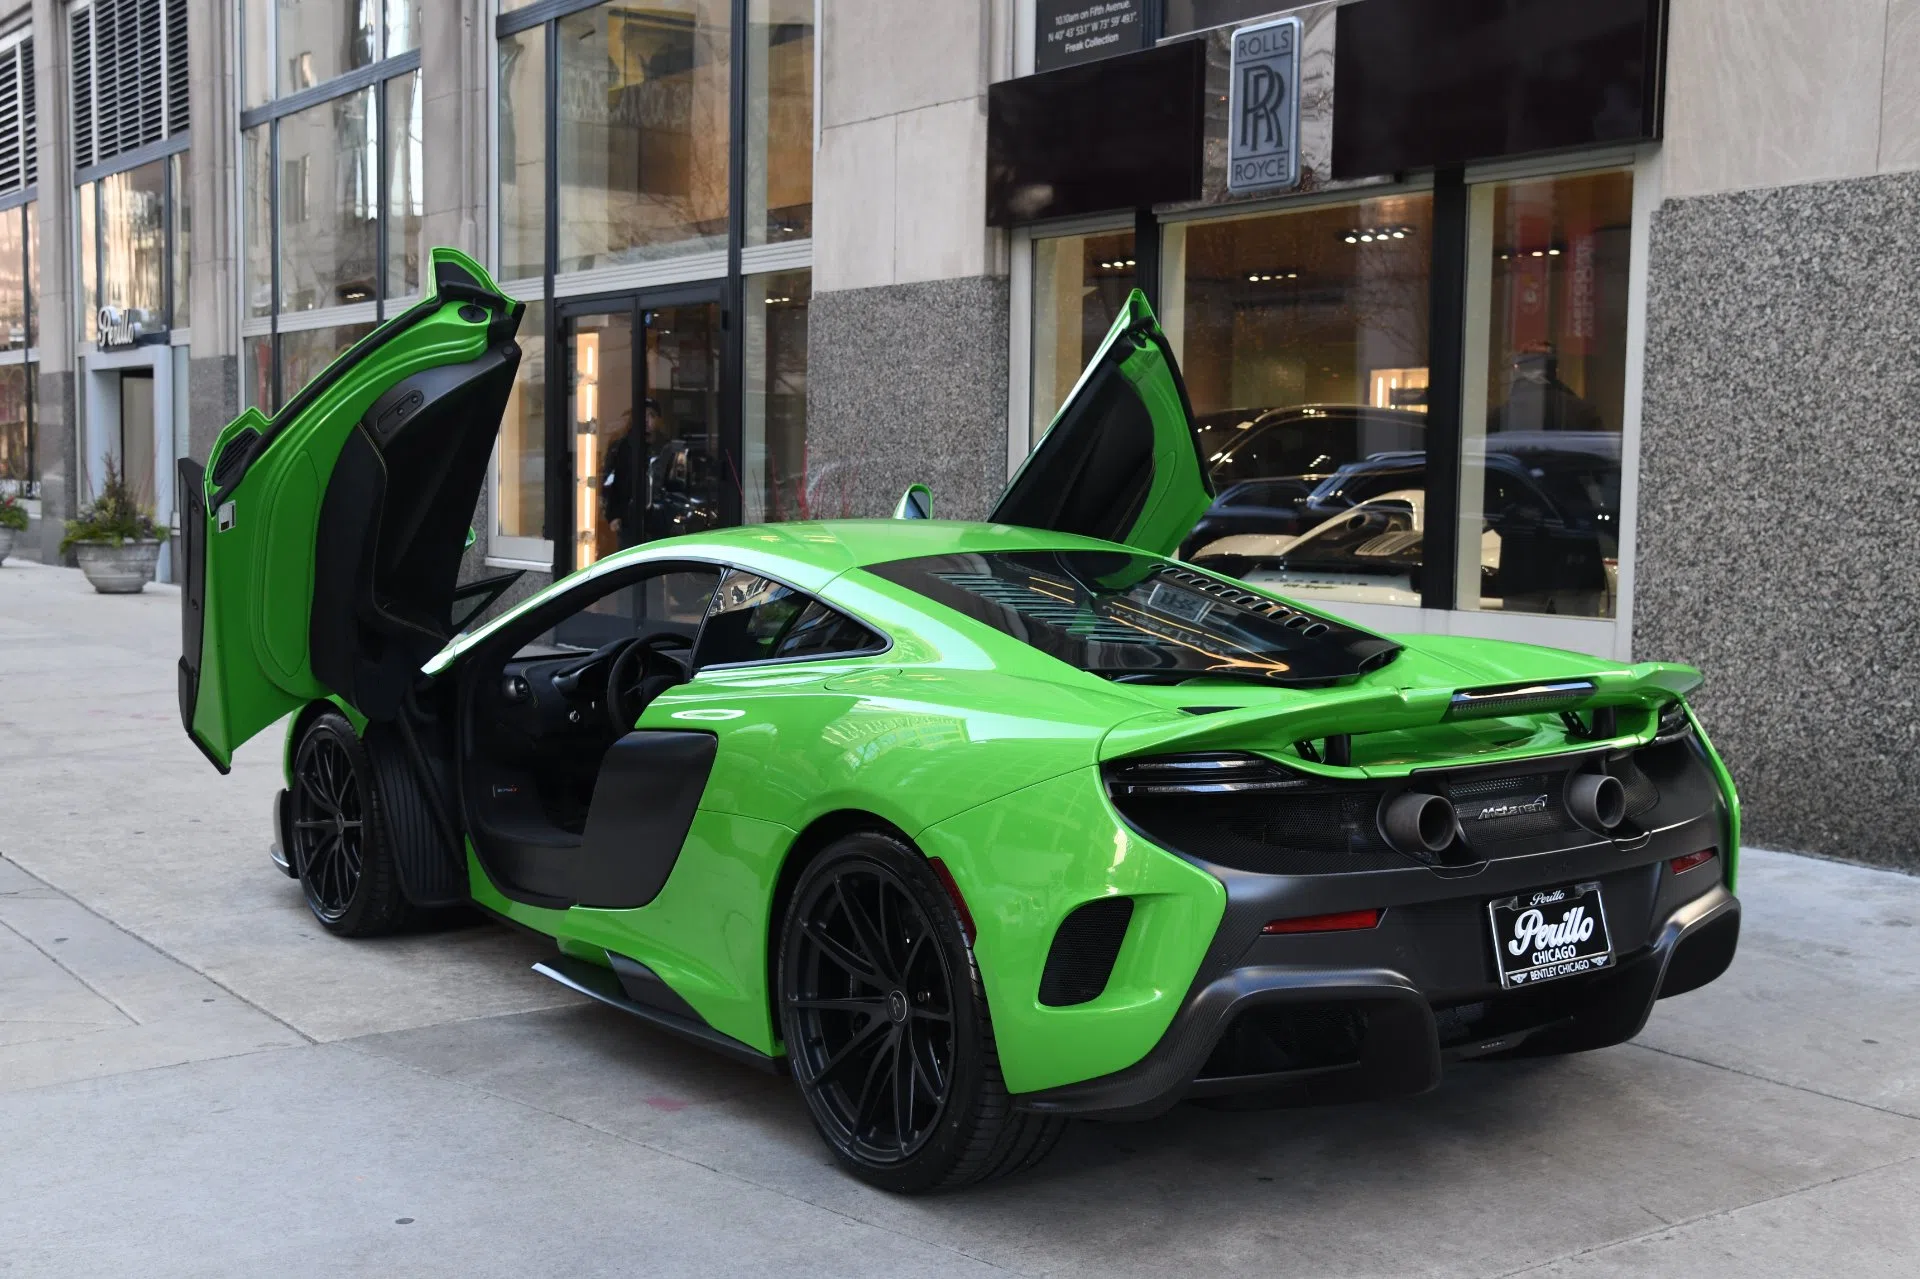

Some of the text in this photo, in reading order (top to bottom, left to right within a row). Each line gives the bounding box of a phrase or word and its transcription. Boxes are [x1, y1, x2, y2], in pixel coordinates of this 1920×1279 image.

[1079, 10, 1089, 19] on
[1090, 5, 1104, 17] Fifth
[1048, 31, 1055, 42] N
[1084, 33, 1120, 48] Collection
[1238, 29, 1290, 58] ROLLS
[1234, 157, 1286, 182] ROYCE
[97, 305, 139, 348] Perillo
[1478, 802, 1545, 820] McLaren
[1529, 889, 1565, 907] Perillo
[1508, 906, 1594, 956] Perillo
[1532, 944, 1576, 965] CHICAGO
[1530, 959, 1590, 981] BENTLEY CHICAGO
